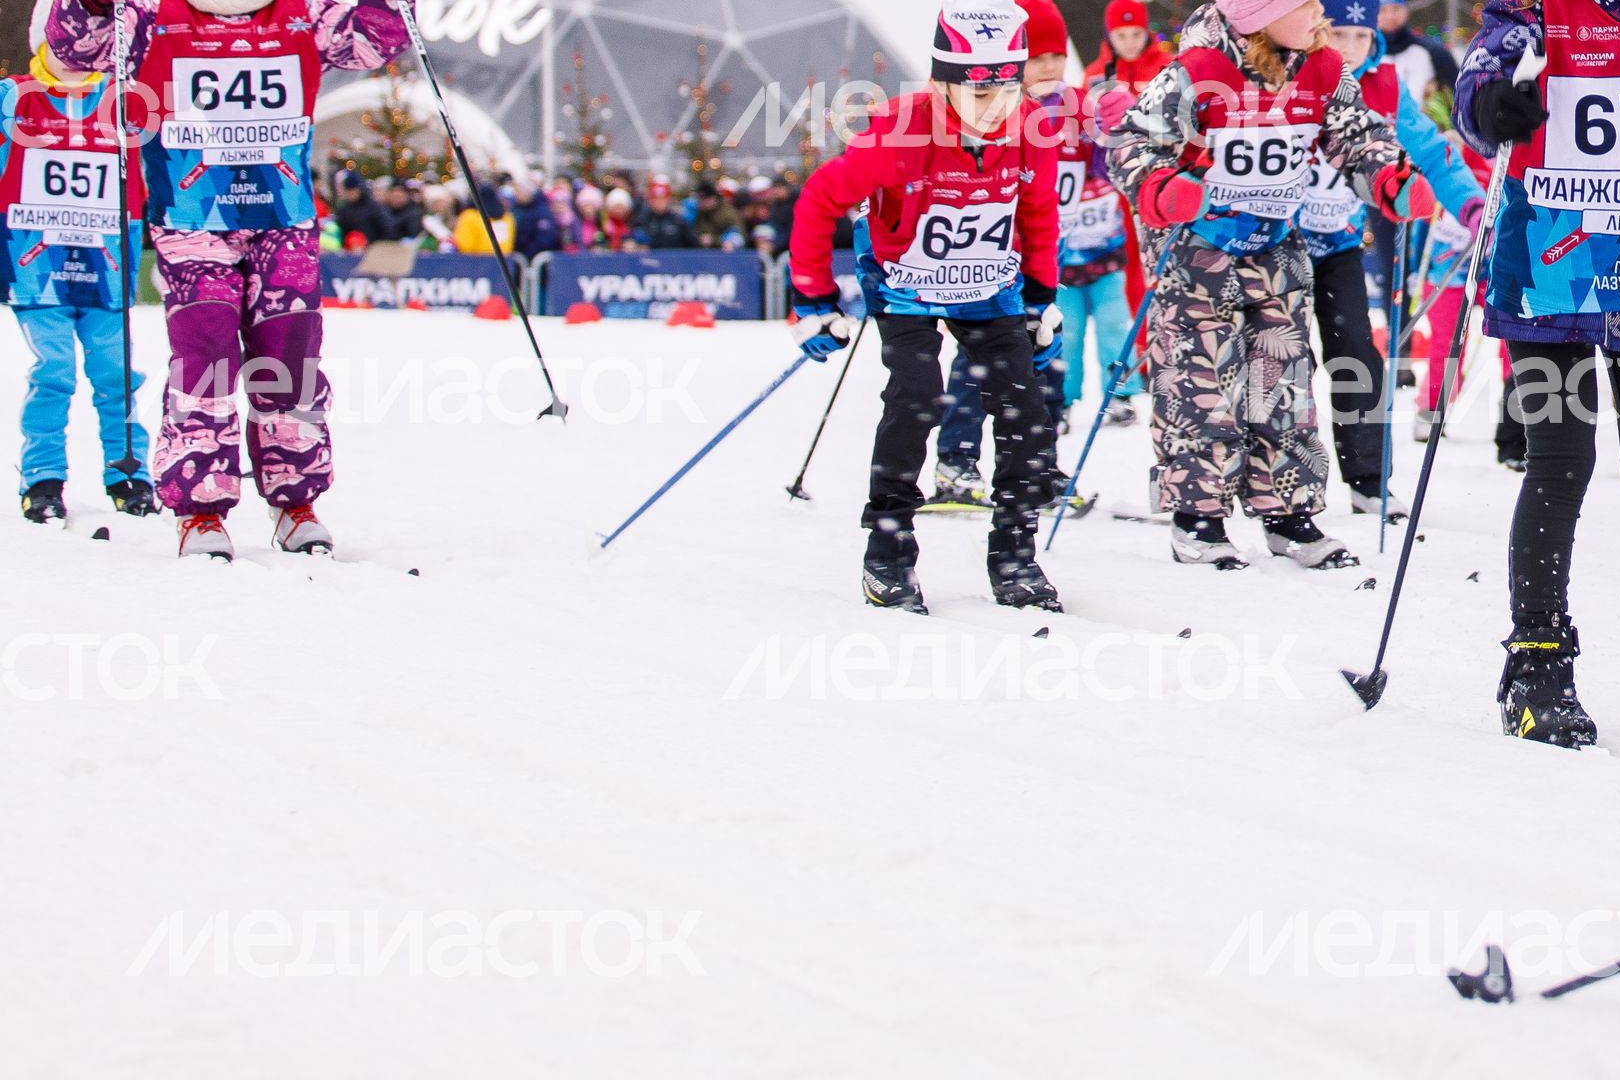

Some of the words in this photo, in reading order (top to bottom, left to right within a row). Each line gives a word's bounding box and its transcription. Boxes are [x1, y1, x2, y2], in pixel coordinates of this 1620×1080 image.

[1592, 25, 1619, 33] ПАРКИ
[1570, 52, 1615, 61] УРАЛХИМ
[191, 68, 288, 111] 645
[167, 120, 306, 144] МАНЖОСОВСКАЯ
[219, 149, 265, 162] ЛЫЖНЯ
[44, 160, 108, 199] 651
[230, 183, 258, 194] ПАРК
[215, 190, 274, 206] ЛАЗУТИНОЙ
[1248, 202, 1288, 216] ЛЫЖНЯ
[922, 214, 1013, 261] 654
[577, 273, 737, 302] УРАЛХИМ
[936, 289, 982, 301] ЛЫЖНЯ
[1508, 641, 1560, 650] FISCHER
